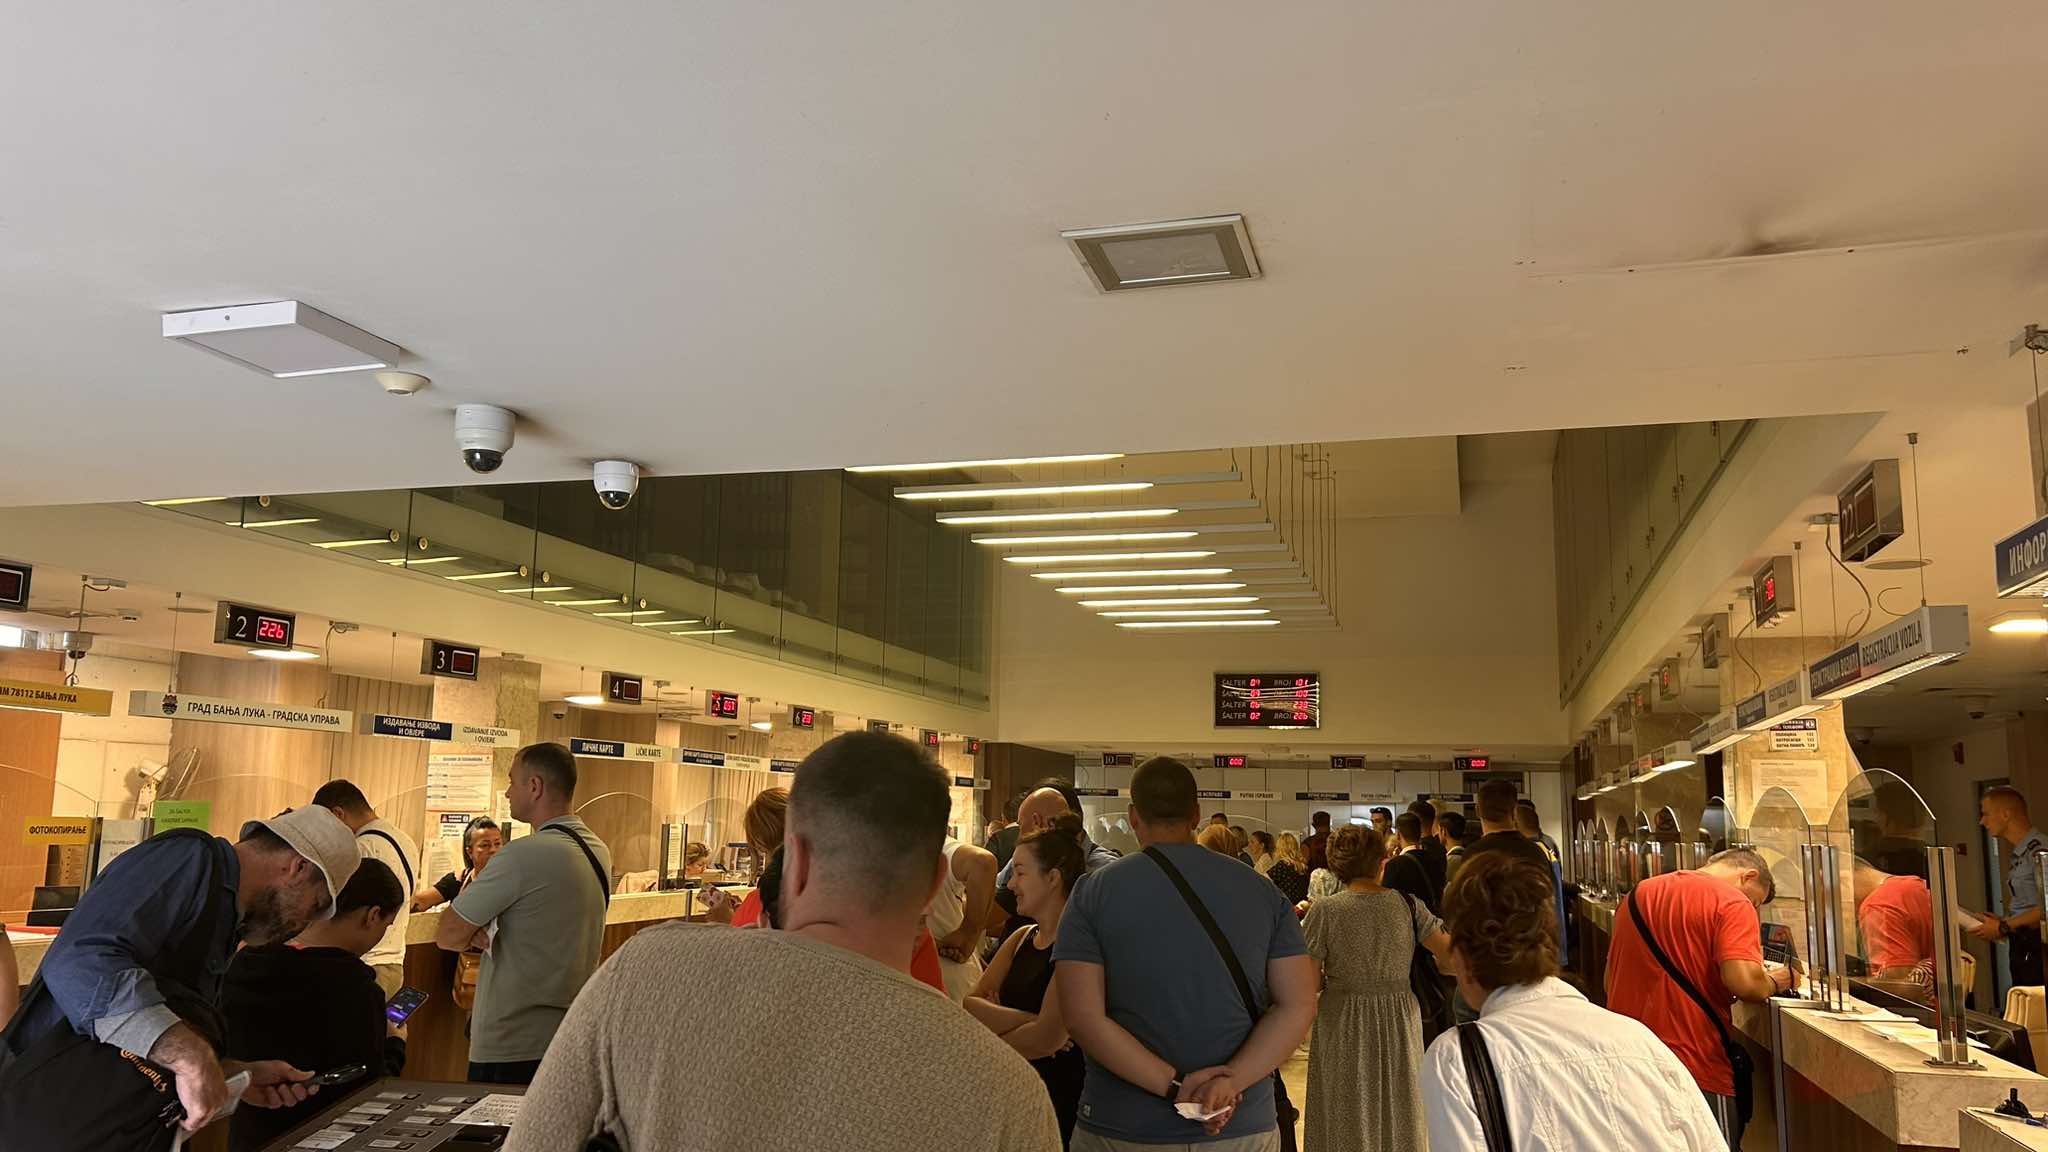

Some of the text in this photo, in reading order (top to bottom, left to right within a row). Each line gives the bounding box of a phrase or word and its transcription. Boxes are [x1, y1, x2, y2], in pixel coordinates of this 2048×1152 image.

[2009, 529, 2048, 577] ИНФОР
[235, 616, 247, 637] 2
[259, 621, 284, 638] 226
[1862, 620, 1922, 668] REGISTRACIJA VOZILA
[437, 650, 445, 669] 3
[11, 687, 34, 698] 78112
[35, 689, 57, 701] БАЊА
[58, 693, 77, 703] ЛУКА
[612, 680, 619, 697] 4
[187, 702, 211, 714] ГРАД
[213, 704, 240, 716] БАЊА
[242, 707, 265, 718] ЛУКА
[272, 710, 309, 722] ГРАДСКА
[310, 714, 340, 725] УПРАВА
[383, 717, 441, 731] ИЗДАВАЊЕ ИЗВОДА
[599, 744, 614, 754] КАРТЕ
[1104, 754, 1114, 765] 10
[1216, 757, 1225, 766] 11
[1333, 758, 1343, 767] 12
[1457, 759, 1467, 768] 13
[29, 825, 87, 835] ФОТОКОПИРАЊЕ
